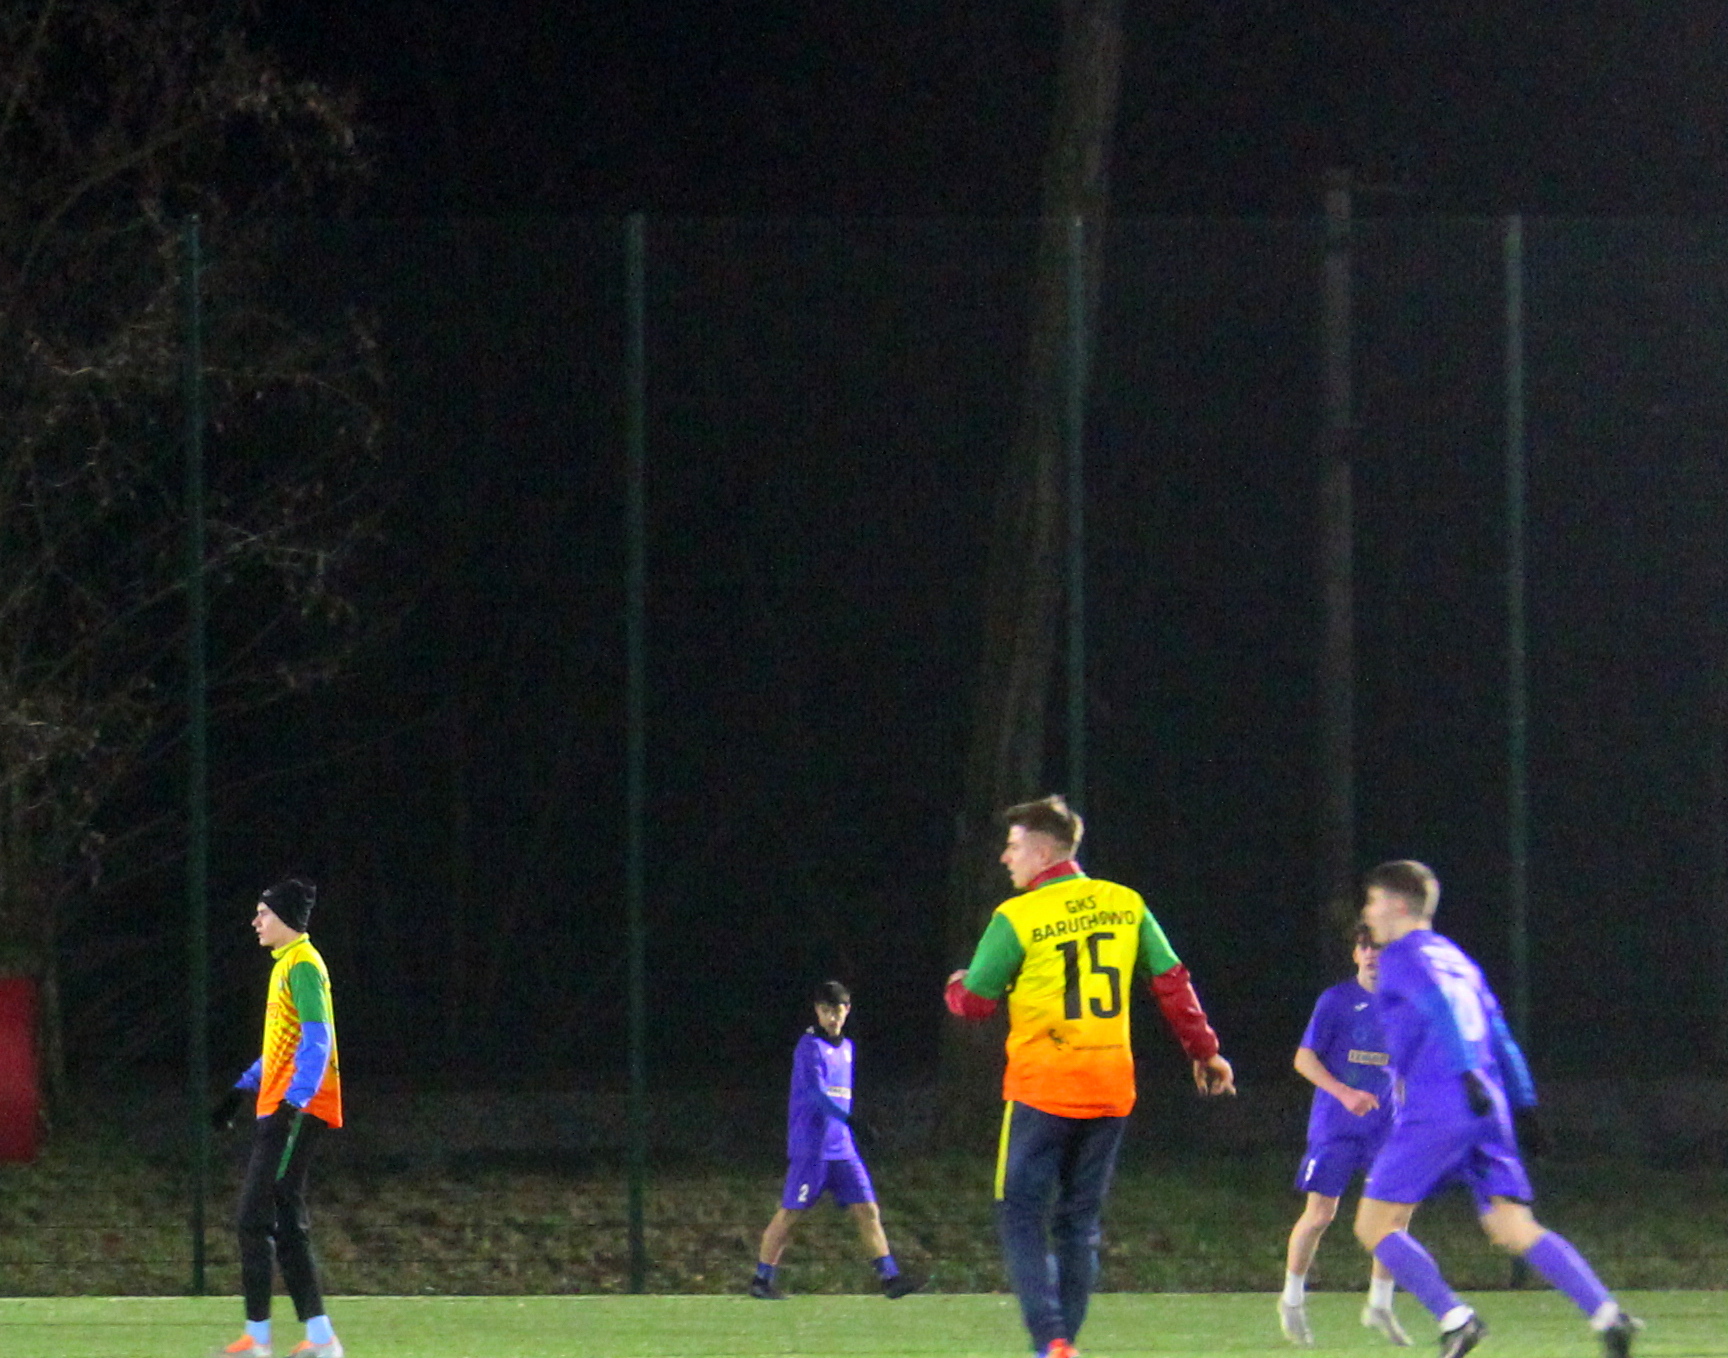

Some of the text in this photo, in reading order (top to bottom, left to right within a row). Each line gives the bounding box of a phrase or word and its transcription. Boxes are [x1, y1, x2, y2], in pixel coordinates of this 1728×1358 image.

[1064, 895, 1097, 914] GKS
[1056, 932, 1122, 1020] 15
[797, 1183, 810, 1203] 2
